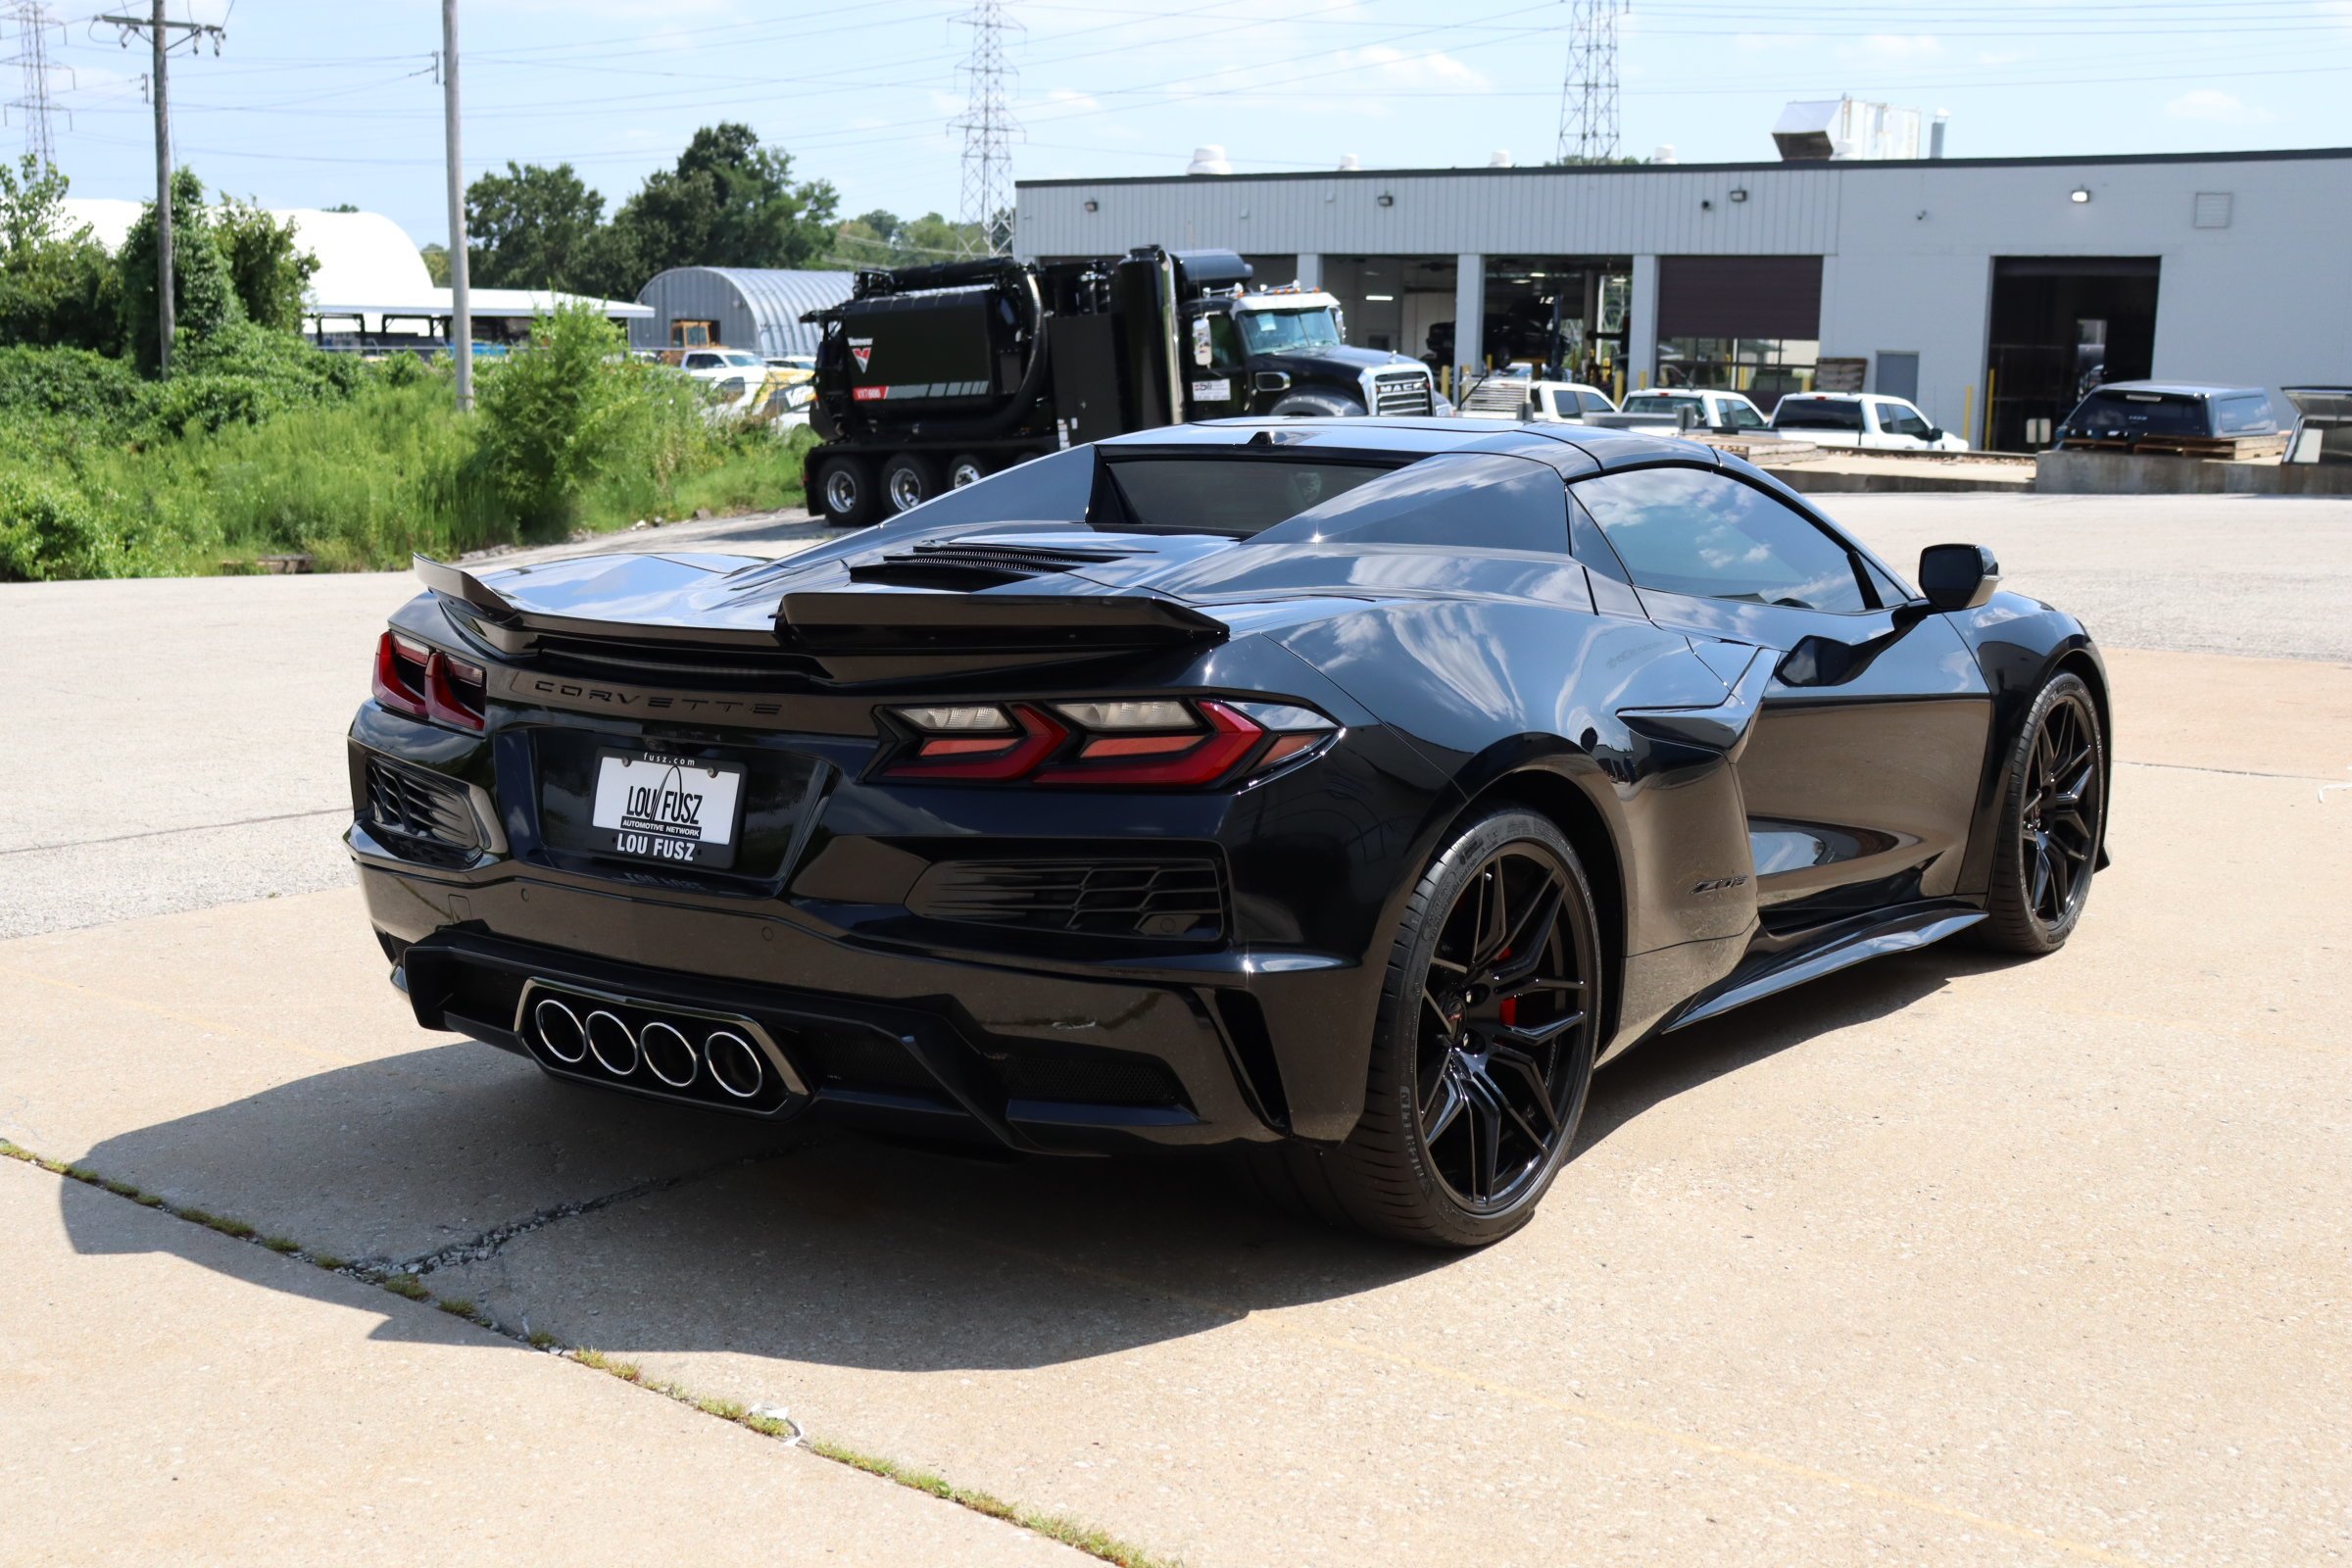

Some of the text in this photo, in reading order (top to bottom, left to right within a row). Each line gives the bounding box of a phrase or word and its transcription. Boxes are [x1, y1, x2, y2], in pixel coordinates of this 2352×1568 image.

[1380, 382, 1424, 393] MACK
[534, 680, 783, 715] CORVETTE
[643, 752, 696, 766] fusz.com
[626, 785, 704, 825] LOU FUSZ
[622, 819, 700, 837] AUTOMOTIVE NETWORK
[616, 833, 696, 861] LOU FUSZ
